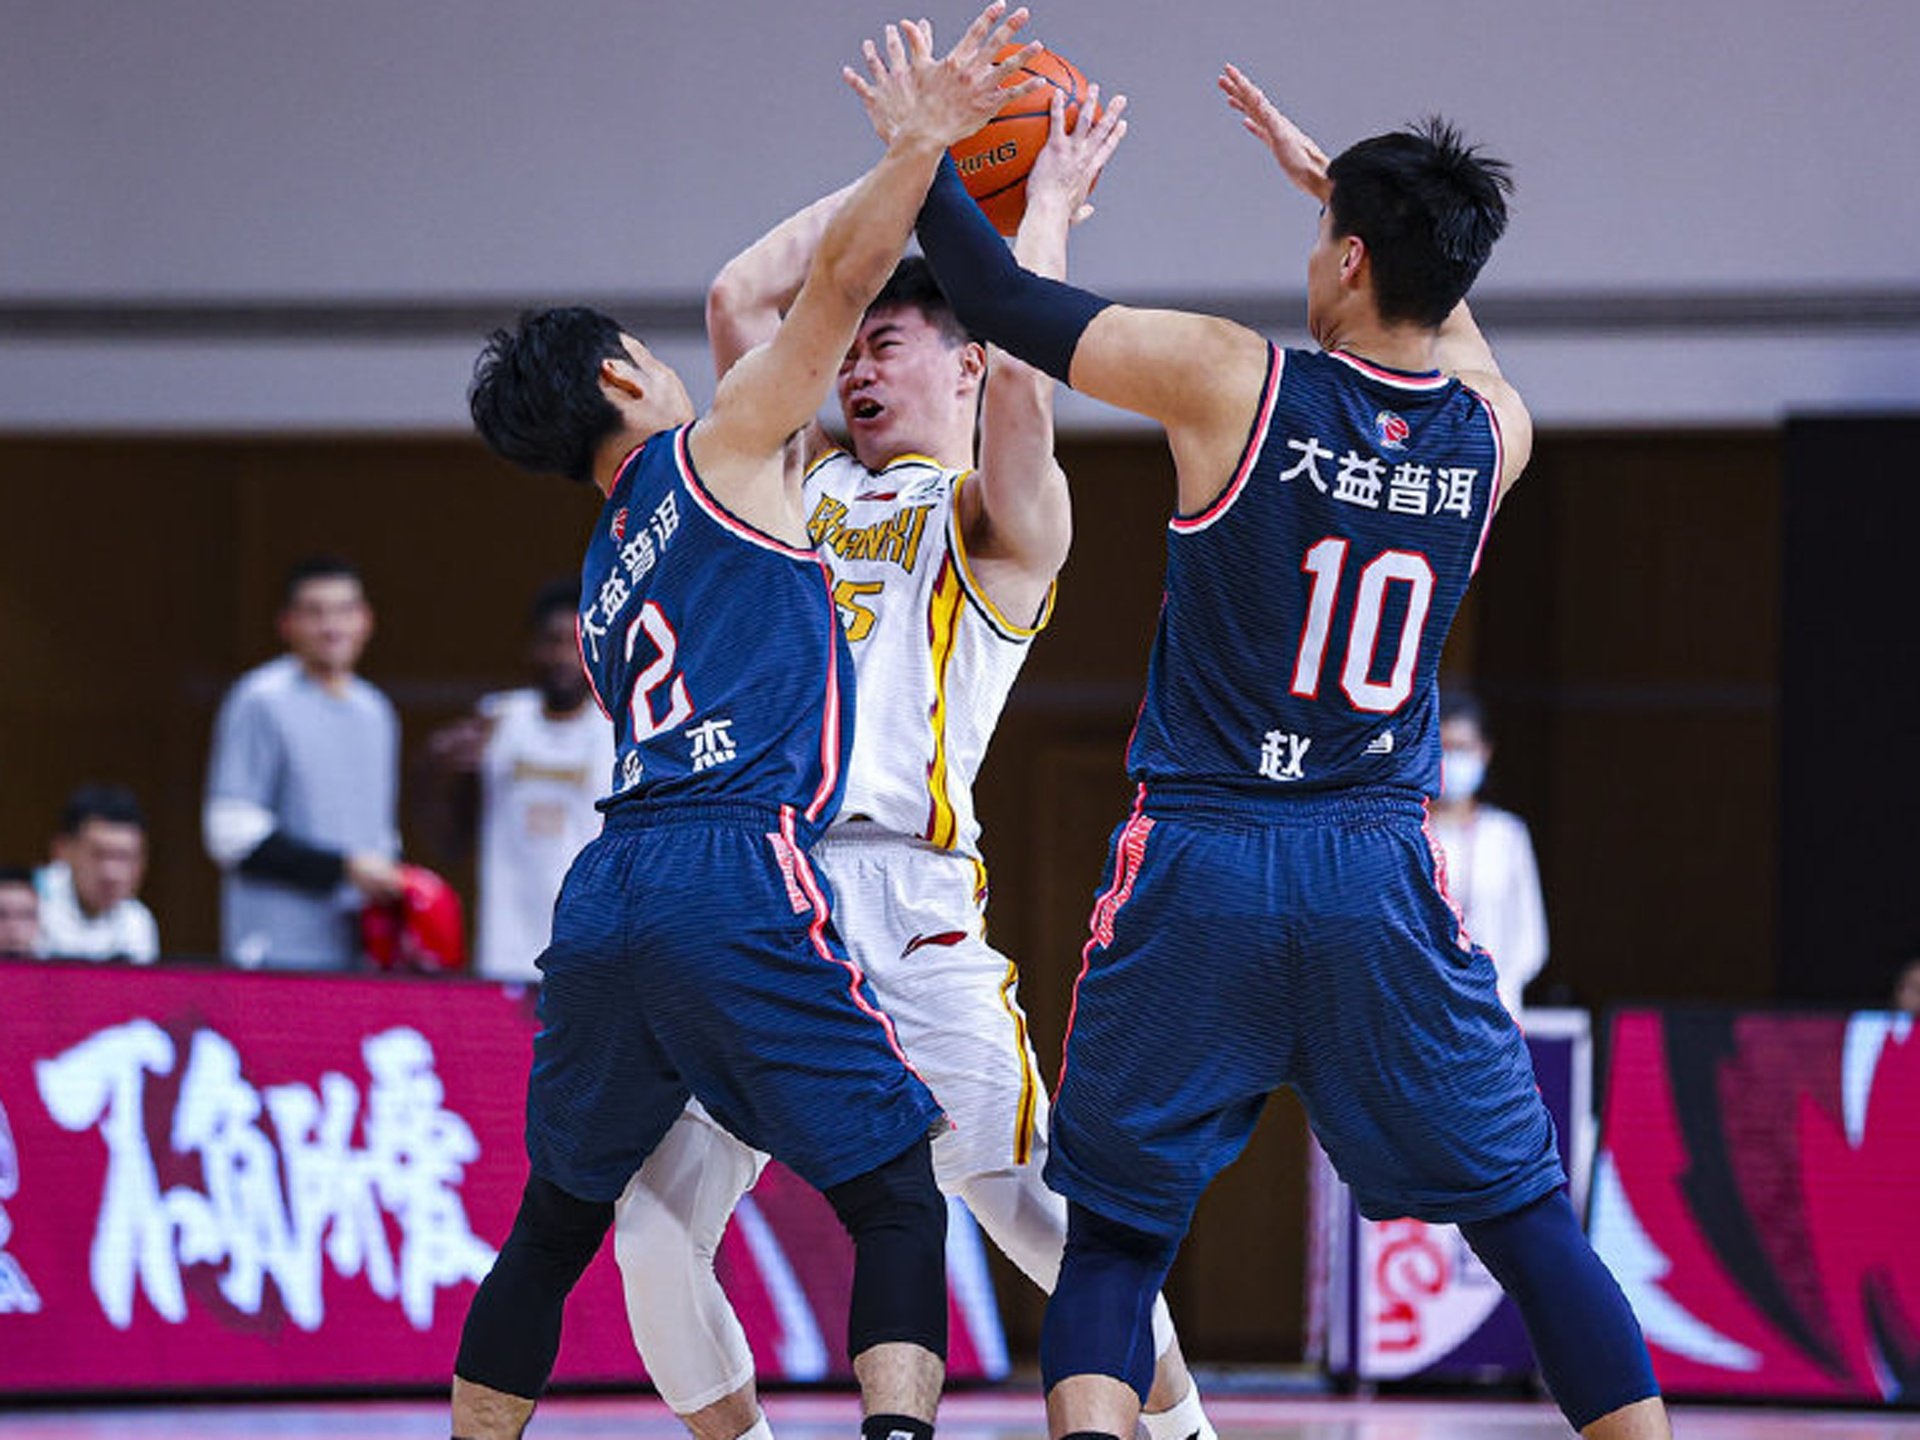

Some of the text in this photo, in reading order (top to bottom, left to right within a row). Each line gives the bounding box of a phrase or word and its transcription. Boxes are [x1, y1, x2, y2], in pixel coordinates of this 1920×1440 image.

[1279, 438, 1478, 519] 大益普洱
[581, 490, 679, 663] 大益普洱
[828, 566, 885, 643] 5
[1288, 535, 1438, 715] 10
[624, 598, 694, 744] 2
[1258, 729, 1312, 782] 赵
